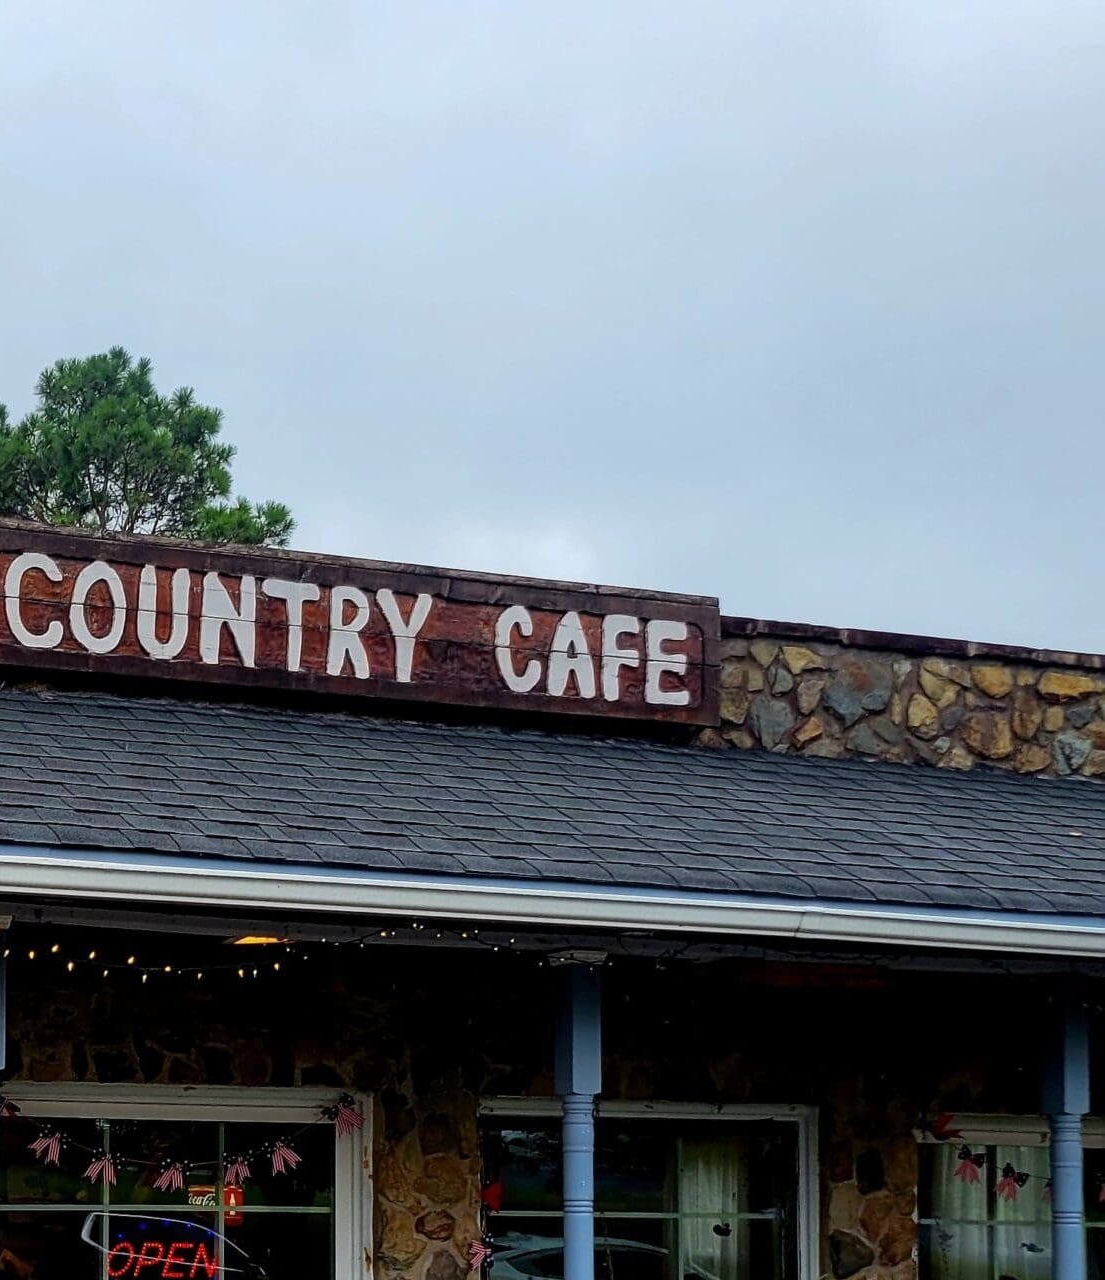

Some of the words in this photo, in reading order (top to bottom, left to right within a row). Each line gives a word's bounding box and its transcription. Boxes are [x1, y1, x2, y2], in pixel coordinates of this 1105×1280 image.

[4, 551, 433, 683] COUNTRY
[494, 604, 690, 705] CAFE
[106, 1241, 219, 1279] OPEN
